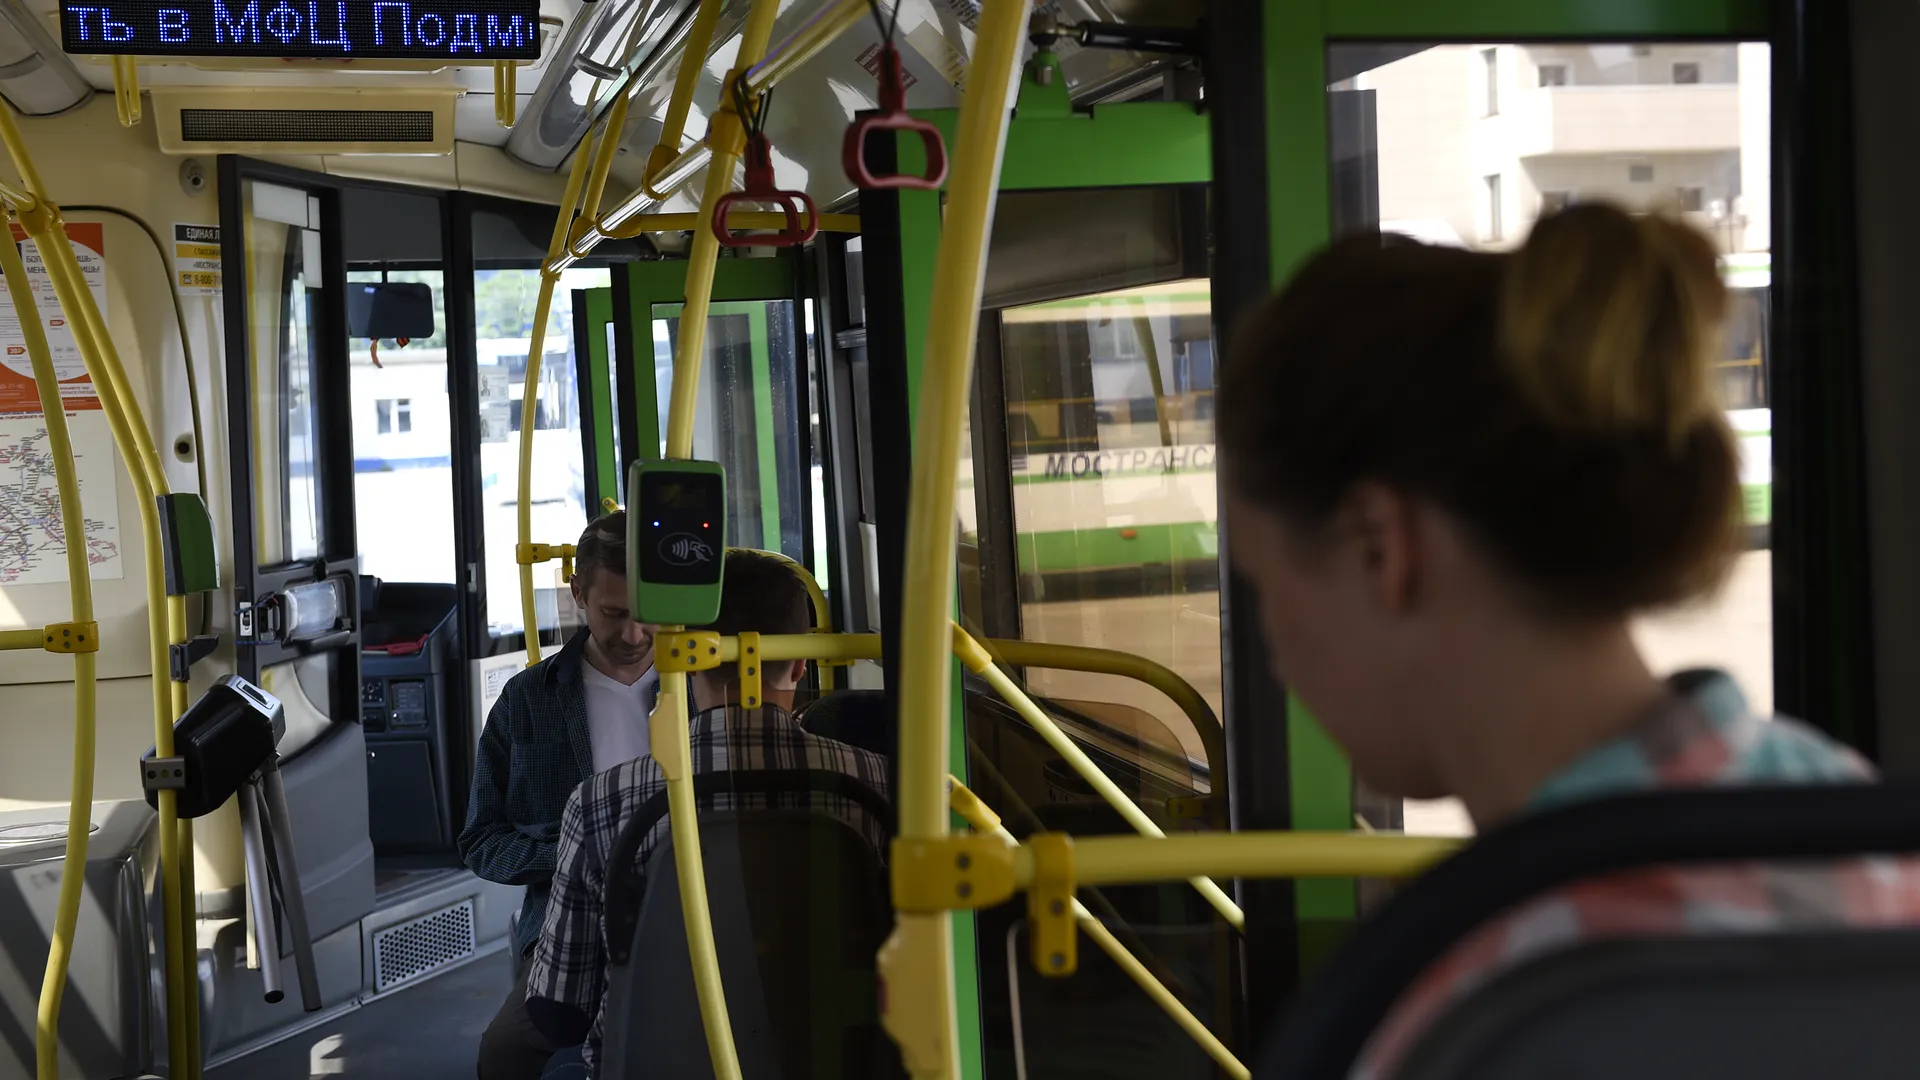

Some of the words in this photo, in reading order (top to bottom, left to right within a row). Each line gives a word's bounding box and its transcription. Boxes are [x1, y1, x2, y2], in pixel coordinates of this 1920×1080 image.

[213, 0, 351, 51] МФЦ
[373, 1, 533, 53] Подм
[186, 227, 213, 240] ЕДИНАЯ
[26, 255, 42, 263] БОЛ
